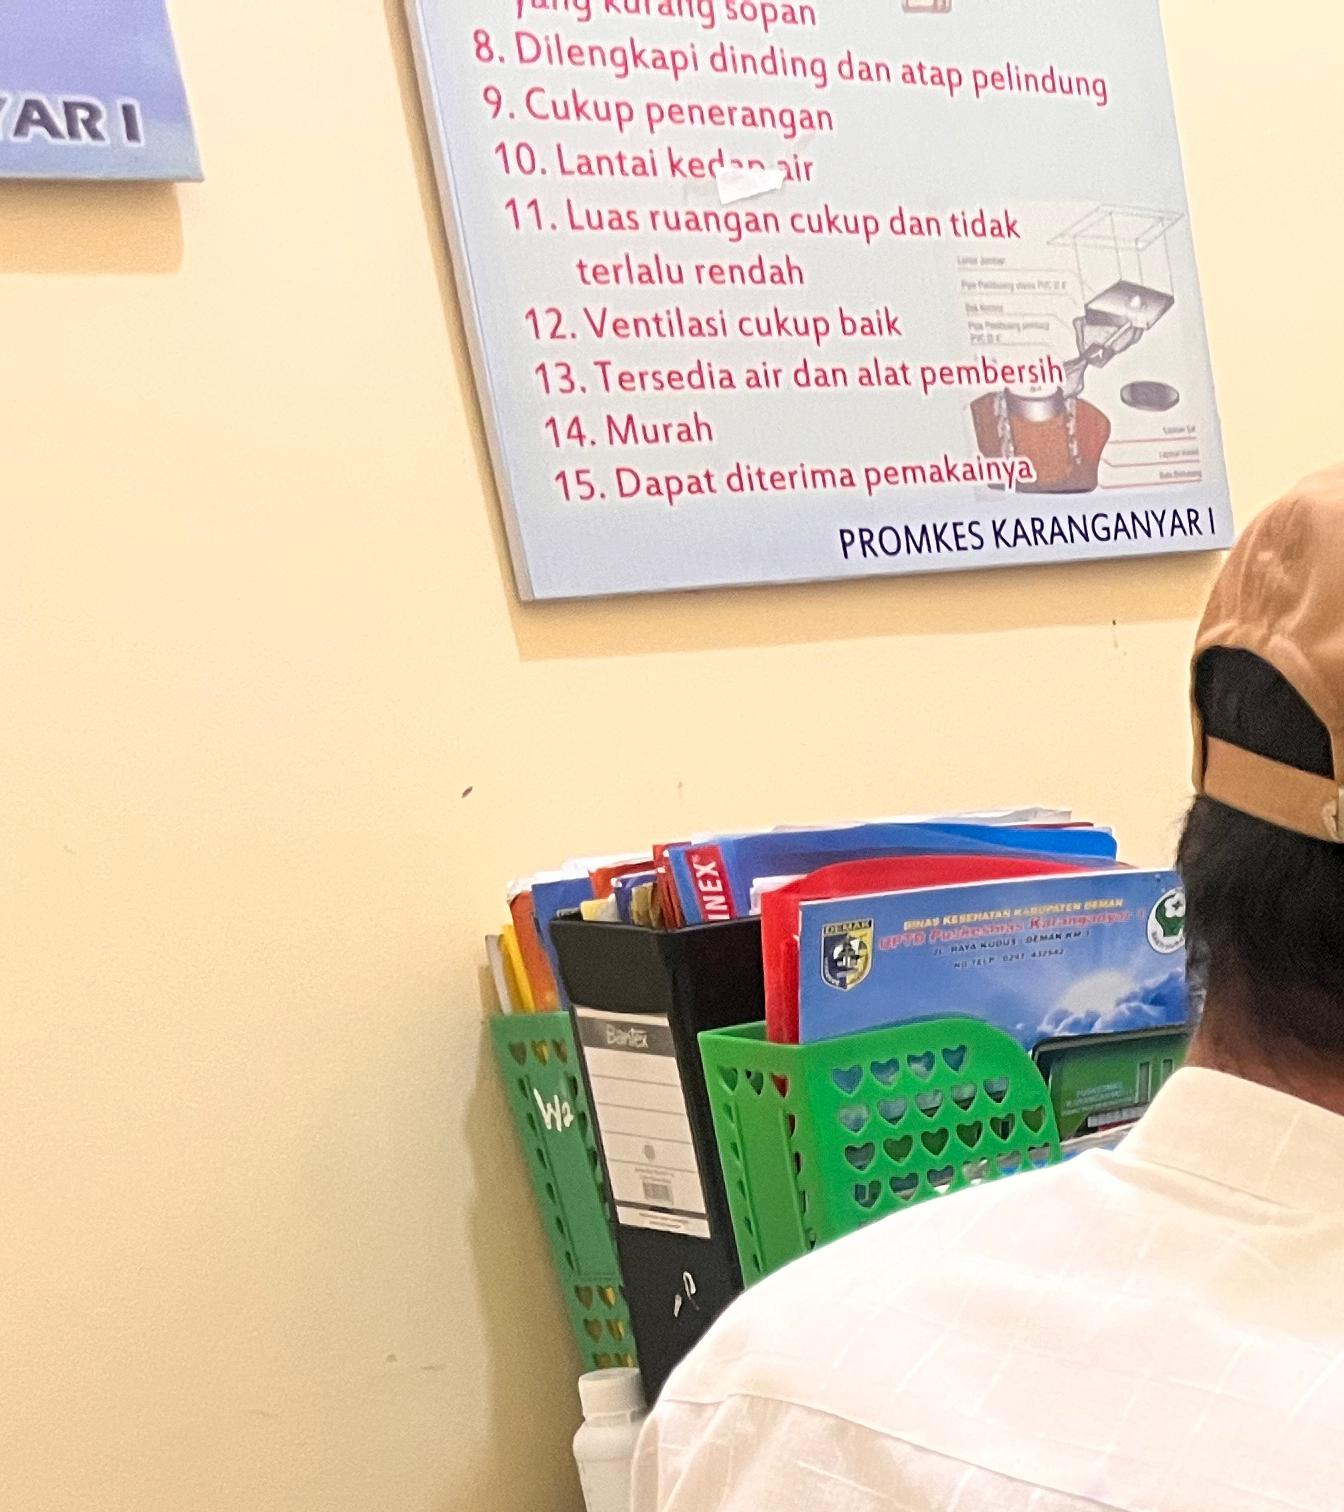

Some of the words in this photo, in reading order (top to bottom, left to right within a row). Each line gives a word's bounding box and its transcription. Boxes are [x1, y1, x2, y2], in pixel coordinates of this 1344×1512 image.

[725, 1, 817, 33] sopan
[472, 28, 505, 64] 8.
[515, 31, 700, 81] Dilengkapi
[709, 41, 829, 89] dinding
[837, 50, 892, 83] dan
[901, 60, 964, 98] atap
[972, 62, 1109, 107] pelindung
[0, 96, 106, 142] AR
[121, 103, 142, 143] I
[482, 85, 515, 119] 9.
[524, 86, 635, 133] Cukup
[645, 102, 834, 139] penerangan
[494, 141, 547, 176] 10.
[555, 143, 659, 178] Lantai
[777, 153, 814, 182] air
[504, 197, 557, 231] 11.
[566, 198, 640, 232] Luas
[649, 209, 781, 243] ruangan
[790, 204, 880, 244] cukup
[889, 205, 942, 237] dan
[950, 208, 1021, 240] tidak
[575, 253, 685, 286] terlalu
[694, 254, 805, 286] rendah
[525, 306, 577, 341] 12.
[582, 306, 729, 340] Ventilasi
[738, 306, 830, 347] cukup
[838, 305, 903, 337] baik
[535, 361, 588, 395] 13.
[594, 358, 737, 393] Tersedia
[745, 362, 783, 389] air
[793, 357, 849, 388] dan
[858, 356, 911, 388] alat
[920, 355, 1065, 395] pembersih
[544, 414, 597, 448] 14.
[605, 411, 715, 446] Murah
[555, 467, 607, 502] 15.
[614, 465, 718, 507] Dapat
[726, 461, 857, 493] diterima
[864, 454, 1035, 497] pemakainya
[837, 520, 985, 559] PROMKES
[991, 507, 1203, 549] KARANGANYAR
[1208, 506, 1216, 535] I
[942, 909, 1012, 927] KESEHATAN
[1013, 901, 1082, 918] KABUPATEN
[606, 1022, 649, 1049] Bantex
